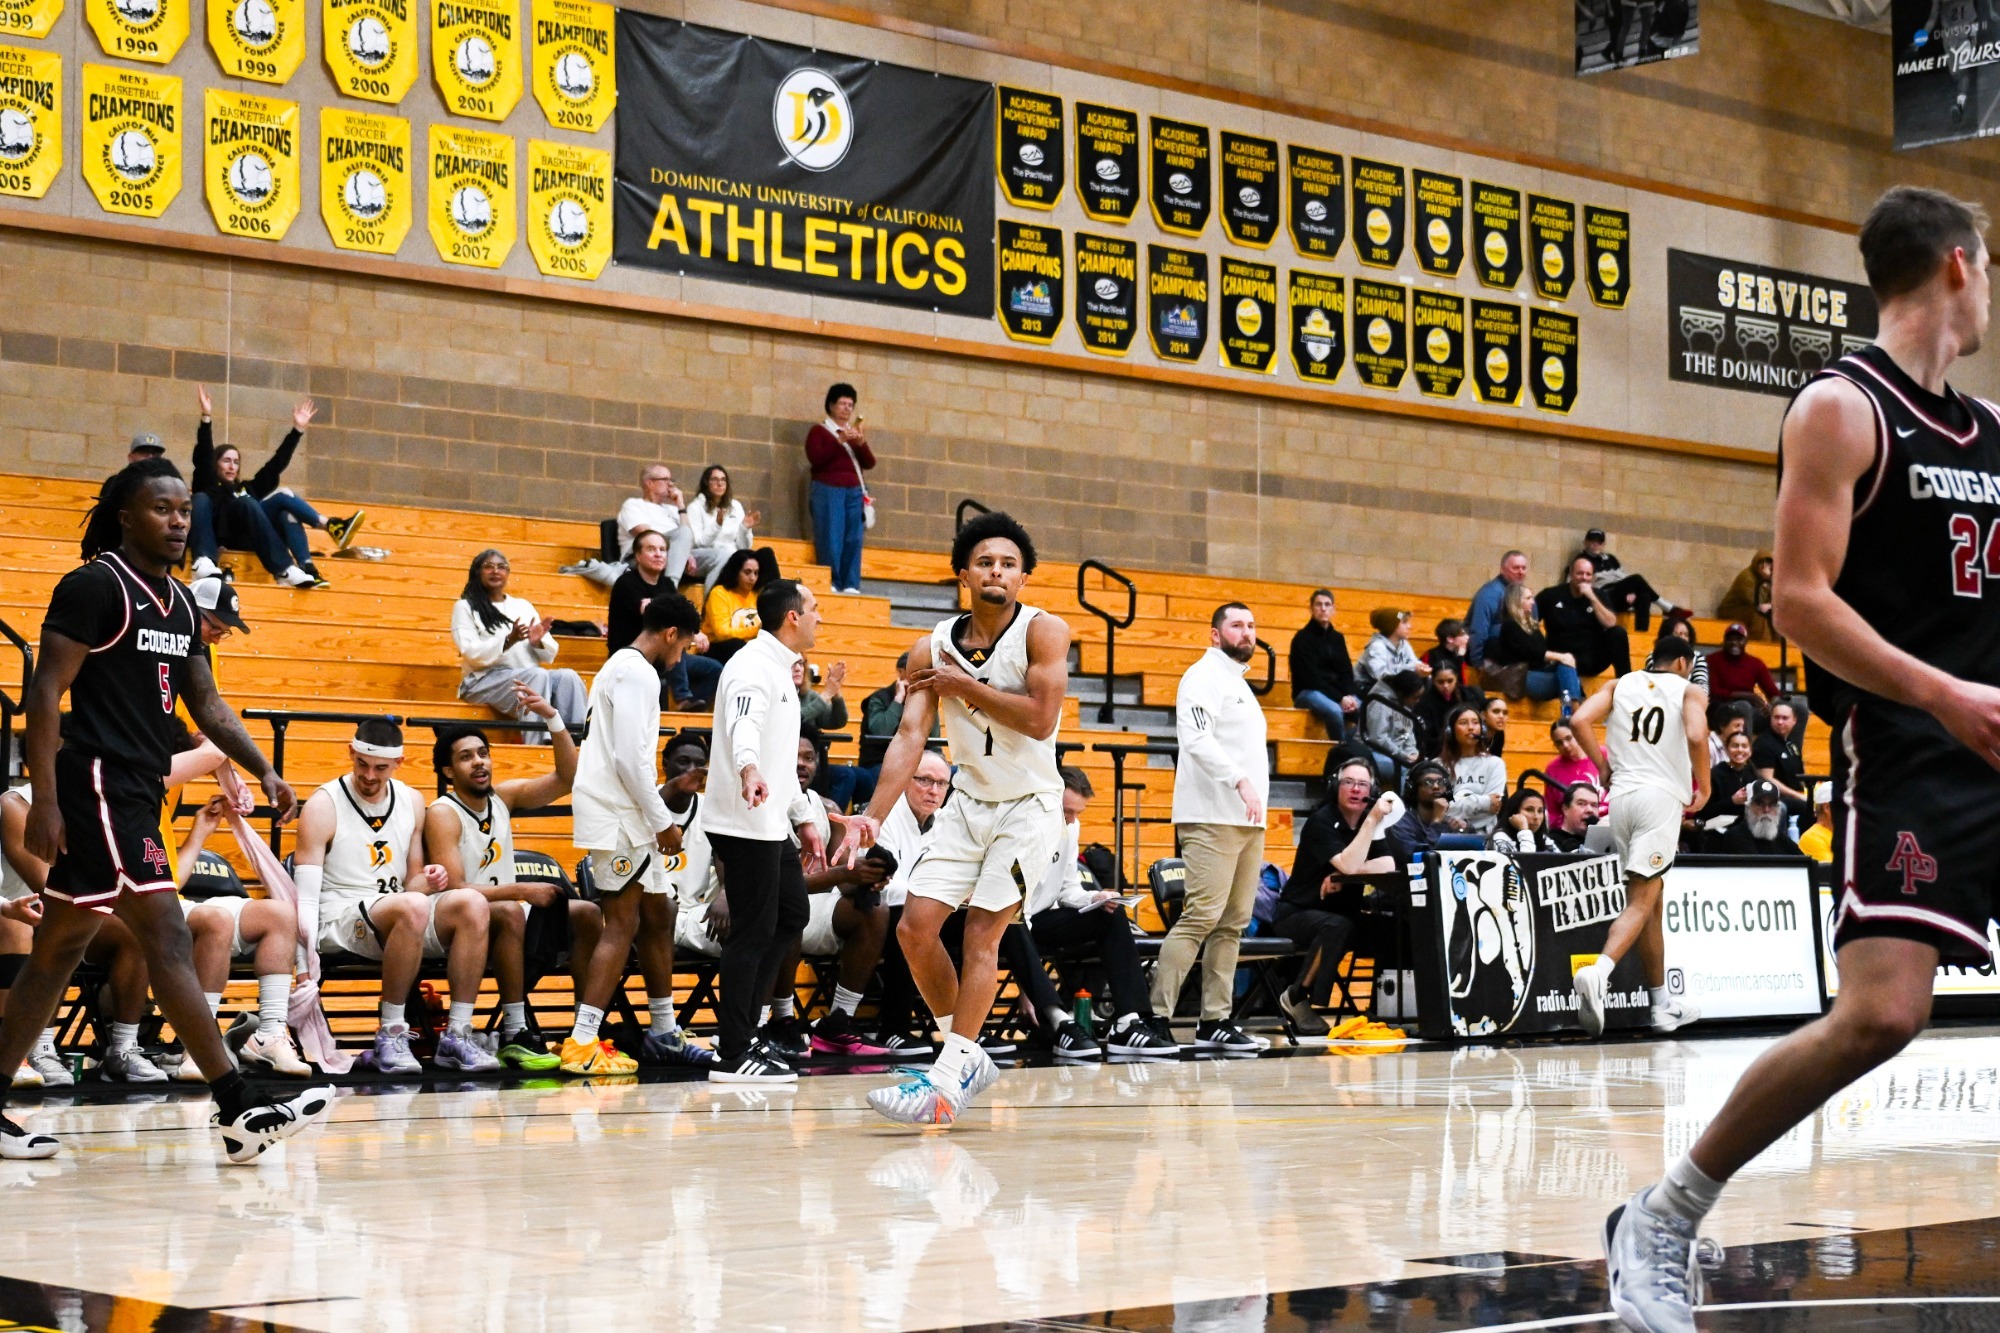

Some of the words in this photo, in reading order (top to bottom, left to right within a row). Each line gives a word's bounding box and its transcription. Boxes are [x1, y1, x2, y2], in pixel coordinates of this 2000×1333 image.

[553, 1, 593, 14] WOMEN'S
[0, 11, 33, 31] 999
[347, 9, 392, 33] CALIFORNIA
[438, 2, 511, 41] CHAMPIONS
[1933, 22, 1979, 40] DIVISION
[226, 9, 242, 48] PACIFIC
[244, 21, 285, 57] CONFERENCE
[455, 28, 498, 51] CALIFORNIA
[538, 20, 608, 56] CHAMPIONS
[341, 29, 357, 67] PACIFIC
[359, 41, 397, 75] CONFERENCE
[237, 59, 277, 78] 1999
[1896, 57, 1935, 76] MAKE
[1937, 54, 1950, 69] IT
[119, 73, 149, 86] MEN'S
[350, 77, 390, 96] 2000
[0, 76, 53, 112] MPIONS
[104, 83, 161, 101] BASKETBALL
[89, 93, 174, 133] CHAMPIONS
[239, 99, 268, 112] MEN'S
[458, 95, 494, 113] 2001
[1010, 96, 1052, 115] ACADEMIC
[219, 106, 286, 127] BASKETBALL
[345, 115, 387, 130] WOMEN'S
[557, 109, 593, 128] 2002
[1004, 107, 1060, 129] ACHIEVEMENT
[1086, 112, 1128, 130] ACADEMIC
[210, 117, 291, 158] CHAMPIONS
[344, 125, 387, 142] SOCCER
[453, 133, 498, 147] WOMEN'S
[1017, 124, 1047, 140] AWARD
[1081, 124, 1135, 144] ACHIEVEMENT
[1160, 127, 1199, 145] ACADEMIC
[227, 145, 276, 169] CALIFORNIA
[327, 137, 403, 174] CHAMPIONS
[558, 149, 588, 161] MEN'S
[1093, 139, 1122, 155] AWARD
[1154, 138, 1207, 159] ACHIEVEMENT
[1231, 142, 1268, 159] ACADEMIC
[103, 144, 120, 183] PACIFIC
[122, 155, 165, 191] CONFERENCE
[541, 156, 599, 174] BASKETBALL
[1166, 153, 1195, 169] AWARD
[1225, 152, 1276, 172] ACHIEVEMENT
[1298, 155, 1334, 172] ACADEMIC
[342, 161, 389, 185] CALIFORNIA
[435, 153, 508, 190] CHAMPIONS
[1237, 168, 1264, 183] AWARD
[1292, 166, 1341, 186] ACHIEVEMENT
[1360, 166, 1396, 184] ACADEMIC
[0, 175, 31, 192] 005
[221, 167, 238, 206] PACIFIC
[240, 178, 281, 214] CONFERENCE
[533, 167, 604, 203] CHAMPIONS
[1302, 181, 1329, 197] AWARD
[1355, 177, 1403, 197] ACHIEVEMENT
[110, 191, 153, 210] 2005
[650, 167, 752, 199] DOMINICAN
[756, 186, 853, 216] UNIVERSITY
[857, 204, 868, 222] of
[872, 206, 964, 234] CALIFORNIA
[1100, 198, 1120, 211] 2011
[1365, 192, 1391, 207] AWARD
[1480, 190, 1512, 207] ACADEMIC
[1173, 210, 1191, 225] 2012
[1474, 202, 1519, 220] ACHIEVEMENT
[229, 214, 271, 234] 2006
[1484, 215, 1508, 230] AWARD
[345, 228, 384, 246] 2007
[647, 193, 967, 296] ATHLETICS
[1019, 228, 1041, 241] MEN'S
[452, 243, 495, 261] 2007
[1012, 238, 1047, 253] LACROSSE
[550, 255, 588, 273] 2008
[1001, 248, 1061, 279] CHAMPIONS
[1078, 250, 1134, 281] CHAMPION
[1151, 271, 1207, 302] CHAMPIONS
[1222, 275, 1275, 304] CHAMPION
[1290, 285, 1343, 313] CHAMPIONS
[1717, 269, 1848, 328] SERVICE
[1356, 295, 1405, 323] CHAMPION
[1480, 307, 1514, 323] ACADEMIC
[1022, 317, 1042, 332] 2013
[1414, 305, 1462, 334] CHAMPION
[1474, 318, 1519, 335] ACHIEVEMENT
[1484, 332, 1509, 346] AWARD
[1682, 351, 1717, 377] THE
[1722, 358, 1814, 389] DOMINICA
[1908, 464, 2000, 504] COUGA
[137, 628, 192, 658] COUGARS
[158, 662, 173, 714] 5
[1628, 705, 1665, 746] 10
[1885, 830, 1938, 896] AP
[1540, 859, 1621, 902] PENGUI
[1554, 888, 1626, 928] RADIO
[1667, 890, 1798, 933] etics.com
[1691, 971, 1805, 995] @dominicansports
[1536, 986, 1649, 1013] radio.doican.edu
